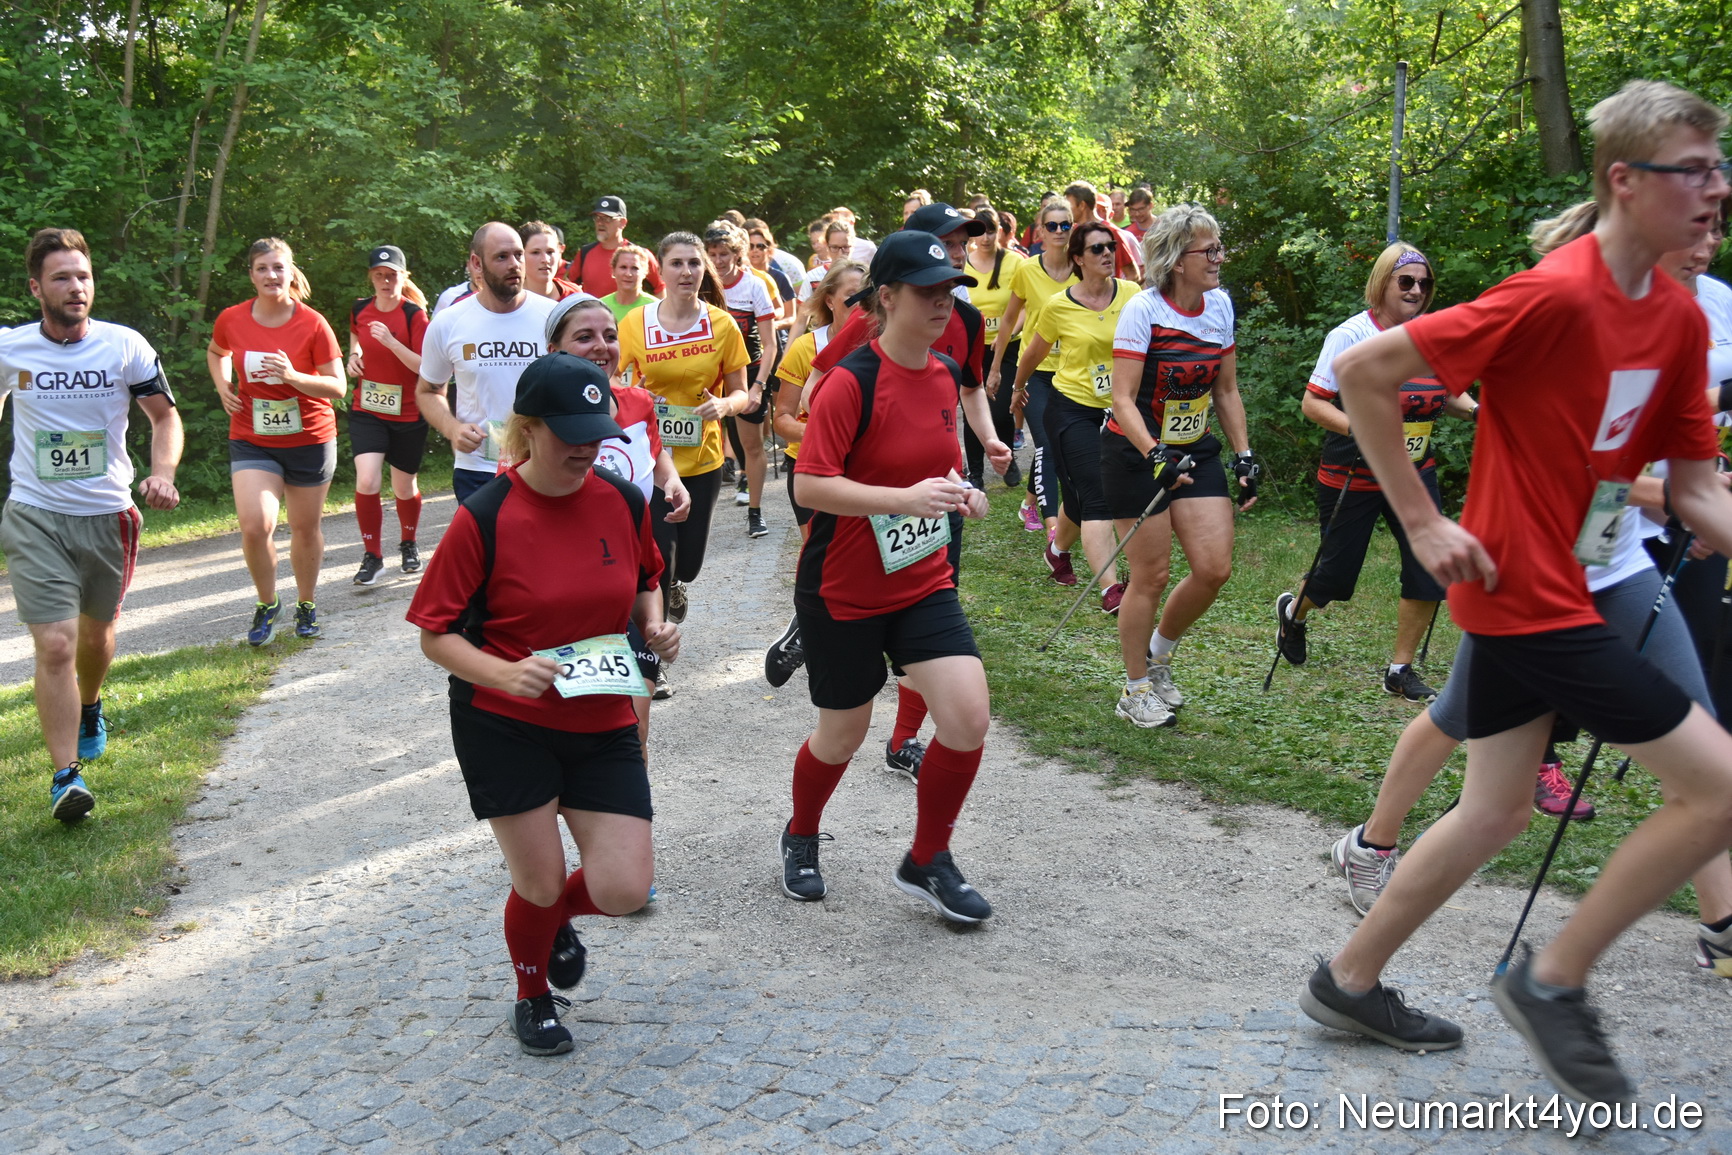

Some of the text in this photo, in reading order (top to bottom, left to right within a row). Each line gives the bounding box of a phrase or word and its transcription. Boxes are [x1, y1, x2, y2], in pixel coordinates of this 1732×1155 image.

[985, 318, 997, 327] 01
[477, 341, 543, 359] GRADL
[645, 343, 717, 364] MAX BÖGL
[35, 369, 115, 391] GRADL
[1095, 374, 1111, 390] 21
[36, 391, 115, 400] HOLZKREATIONEN
[365, 391, 396, 407] 2326
[262, 412, 292, 426] 544
[1168, 410, 1204, 432] 2261
[1405, 436, 1424, 452] 52
[50, 448, 90, 468] 941
[1034, 446, 1047, 506] JUST DO IT
[886, 517, 941, 553] 2342
[599, 537, 612, 558] 1
[1653, 574, 1675, 613] LEKI
[562, 655, 630, 680] 2345
